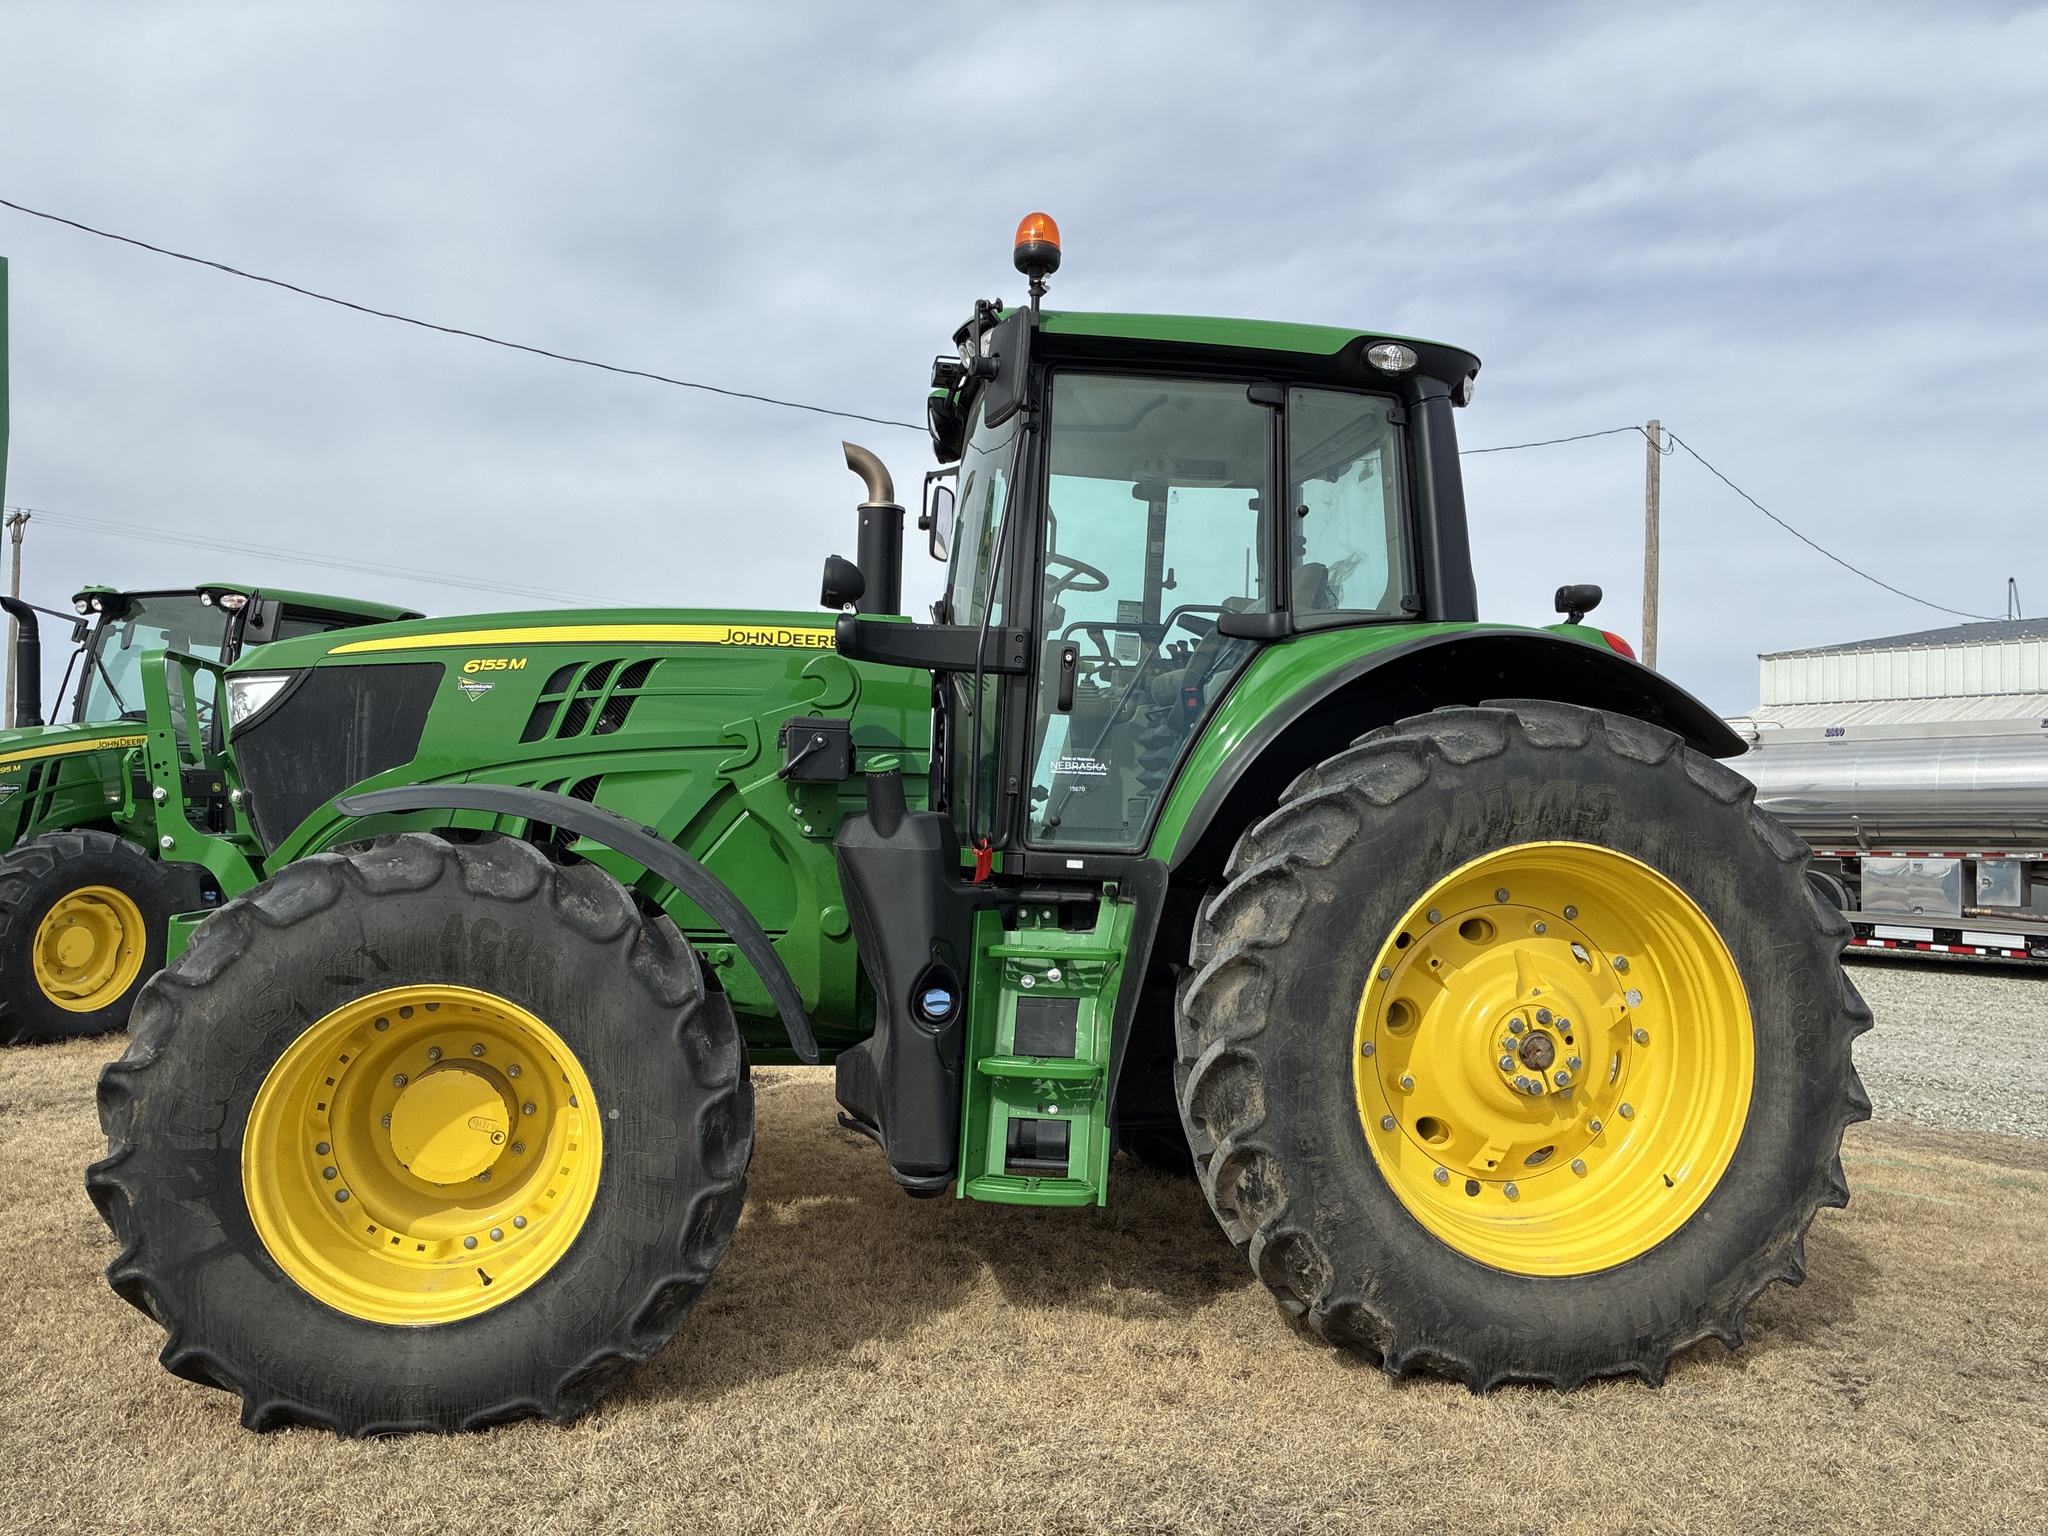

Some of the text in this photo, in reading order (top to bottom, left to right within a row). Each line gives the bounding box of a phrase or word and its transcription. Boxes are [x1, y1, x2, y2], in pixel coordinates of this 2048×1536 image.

[720, 628, 774, 645] JOHN
[96, 740, 120, 749] JOHN
[1050, 761, 1107, 771] NEBRASKA
[438, 911, 563, 973] AC85
